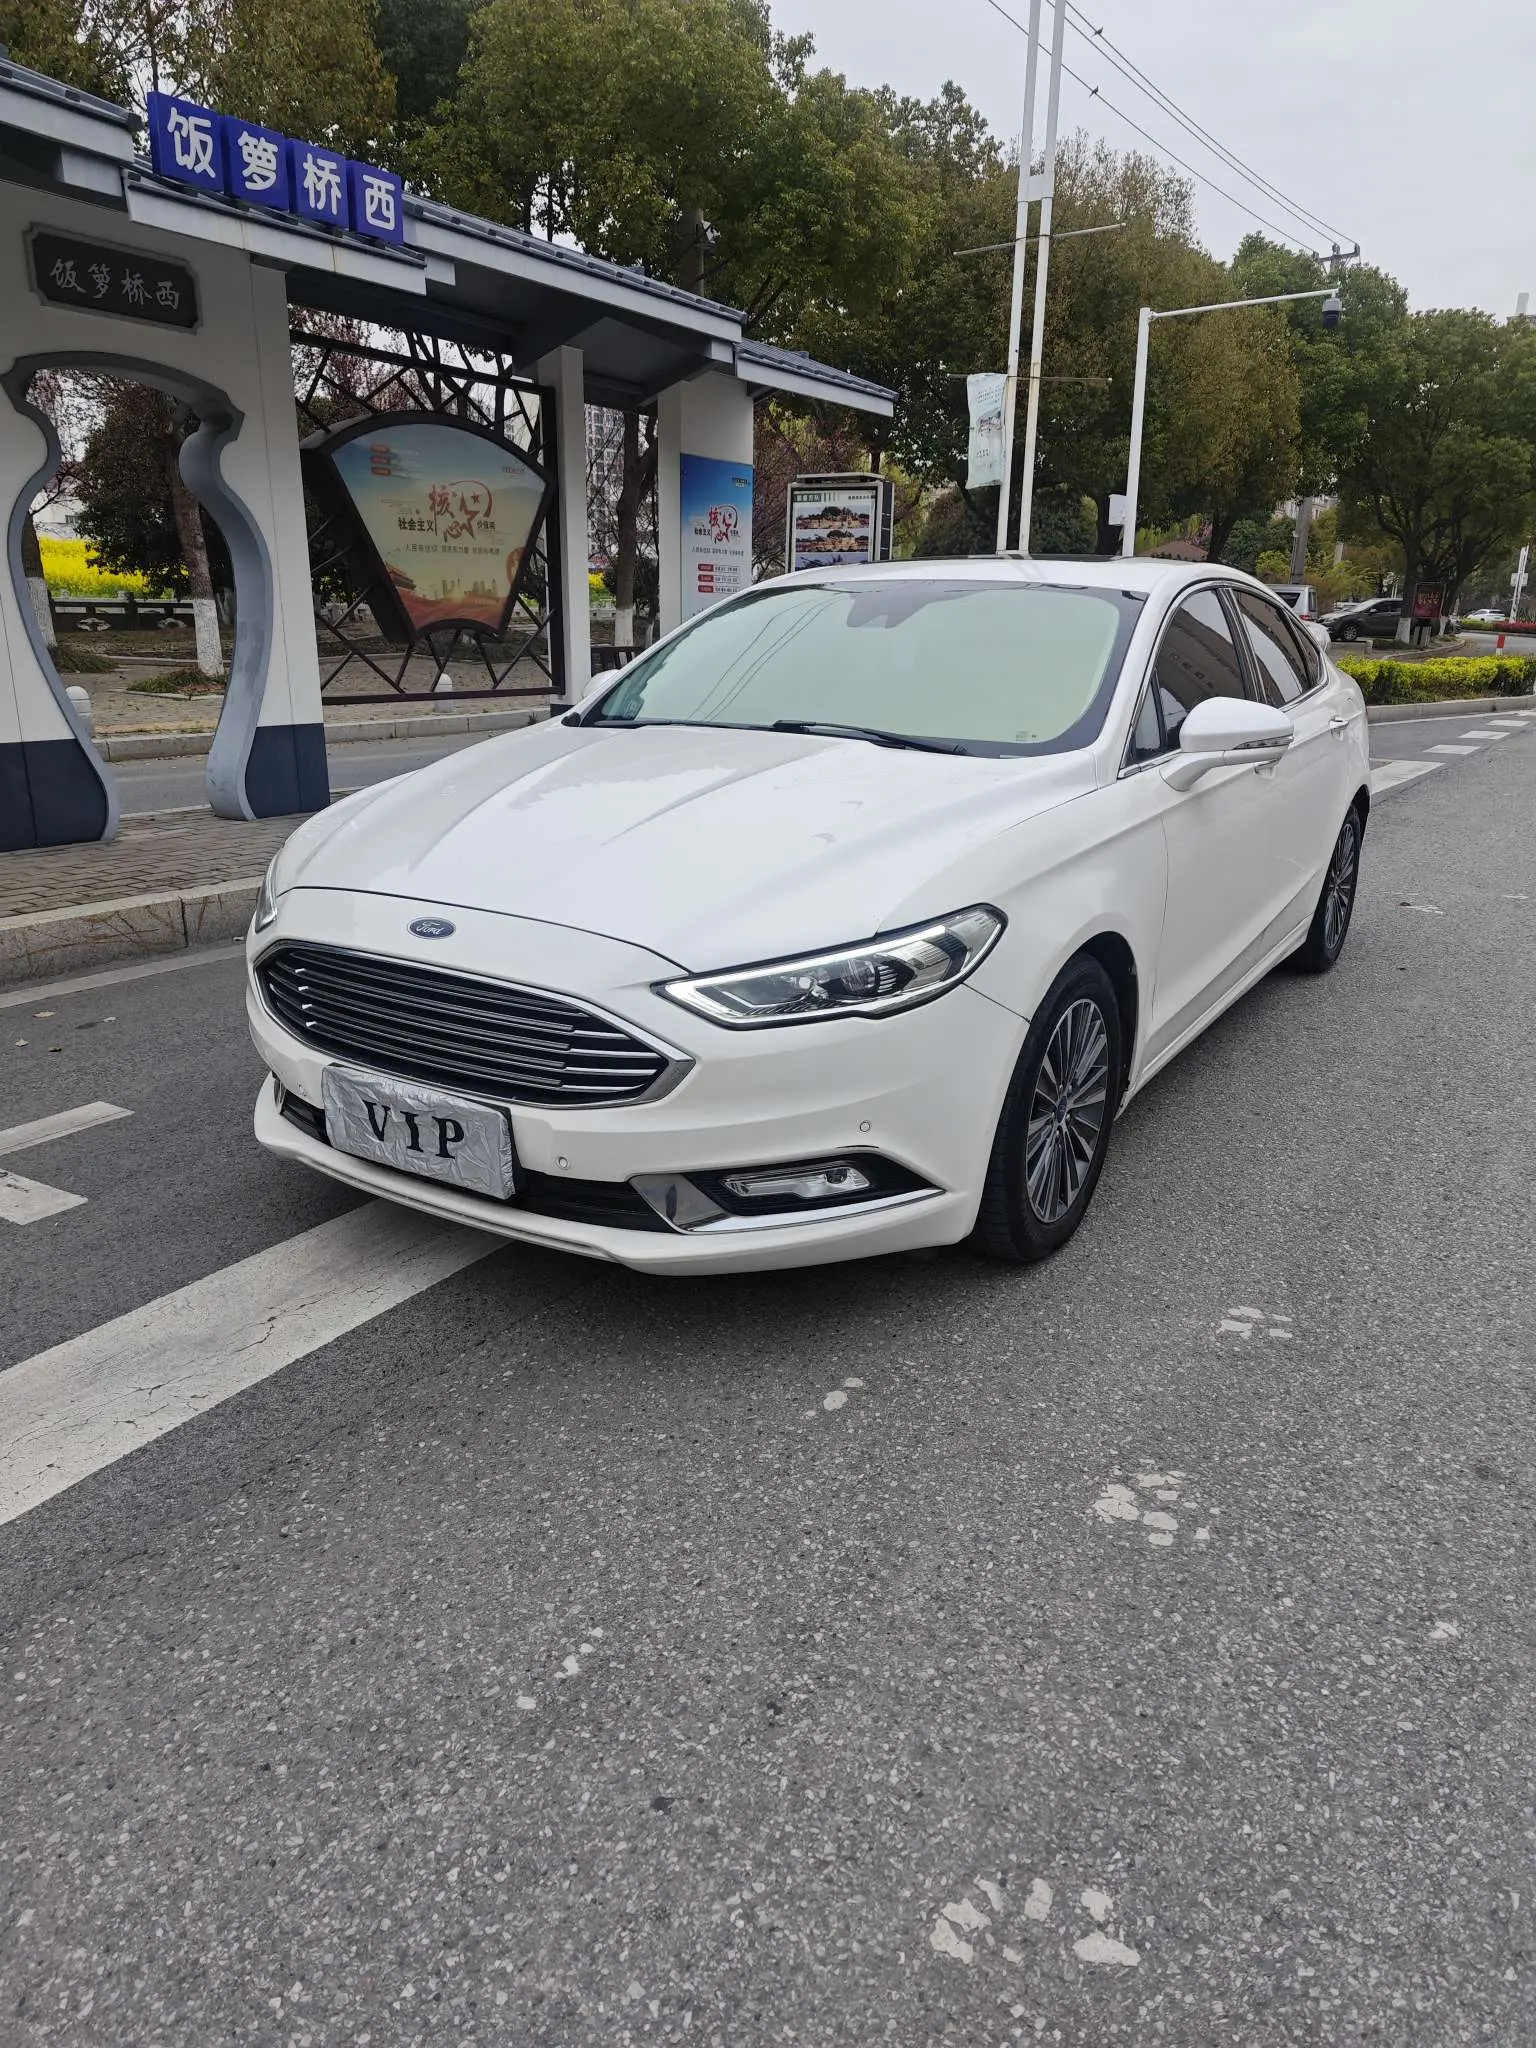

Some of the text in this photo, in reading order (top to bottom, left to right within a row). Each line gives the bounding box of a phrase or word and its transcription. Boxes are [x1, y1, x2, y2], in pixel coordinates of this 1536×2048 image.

[166, 106, 396, 231] 饭箩桥西
[48, 257, 180, 310] 饭箩桥西
[398, 516, 435, 533] 社会主义
[362, 1099, 465, 1160] VIP
